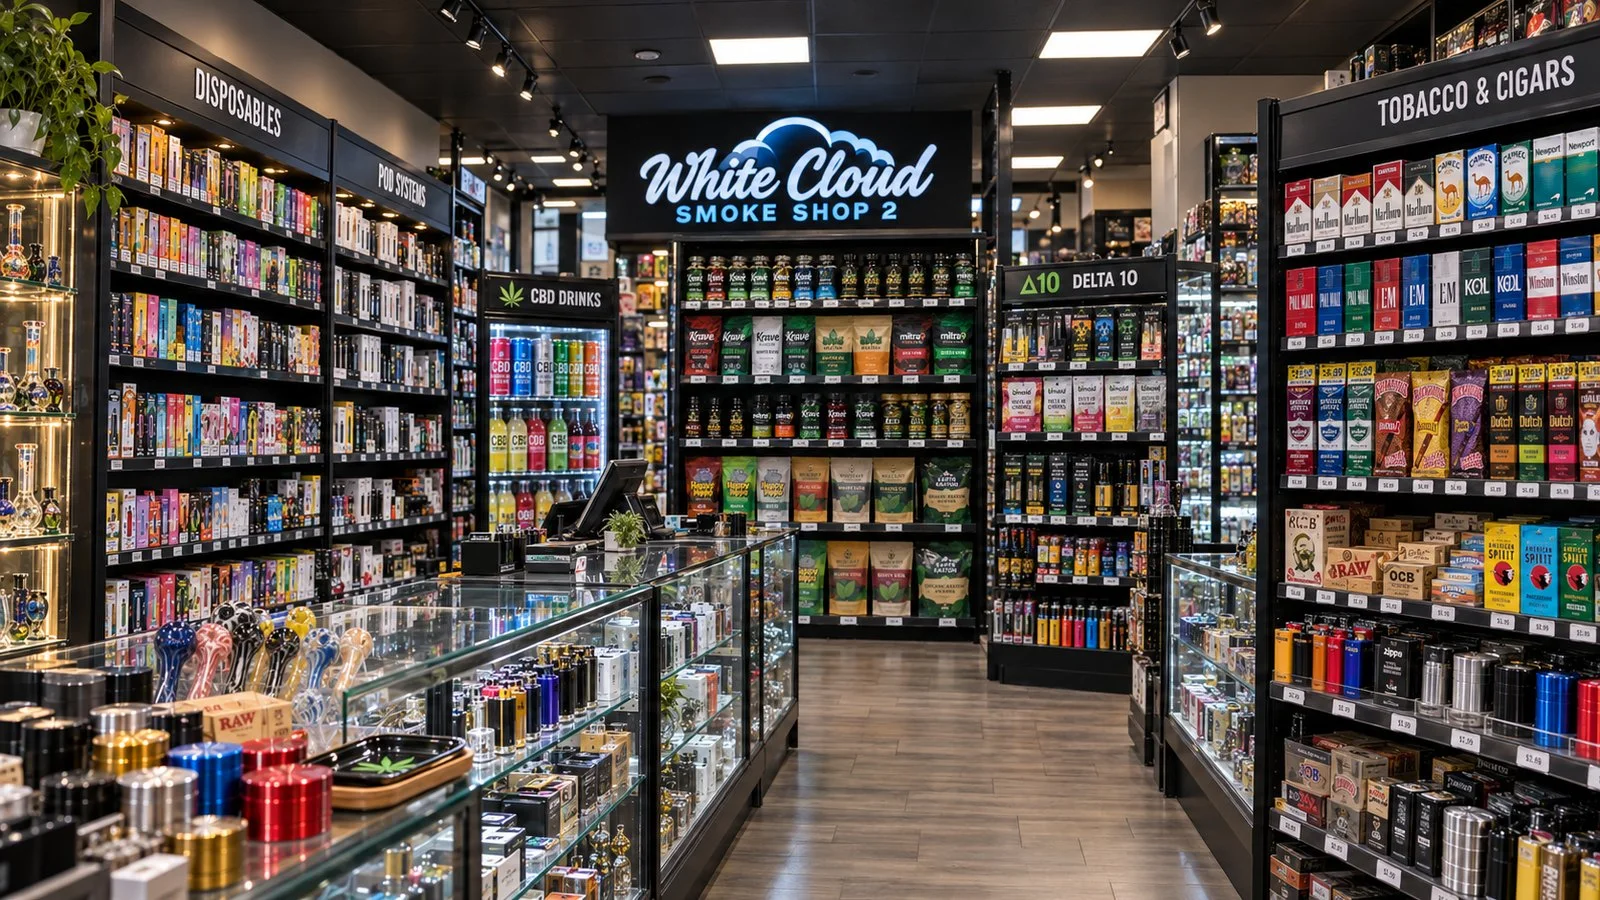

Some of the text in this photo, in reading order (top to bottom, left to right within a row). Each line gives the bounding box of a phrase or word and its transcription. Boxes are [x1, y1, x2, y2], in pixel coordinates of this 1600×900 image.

[1377, 55, 1575, 127] TOBACCO & CIGARS
[195, 67, 282, 138] DISPOSABLES
[1535, 145, 1561, 157] Newport
[1568, 138, 1595, 151] Newport
[639, 143, 938, 205] White Cloud
[378, 162, 427, 208] POD SYSTEMS
[676, 201, 898, 224] SMOKE SHOP 2
[1375, 202, 1401, 220] Marlboro
[1406, 198, 1433, 217] Marlboro
[1286, 217, 1309, 234] Marlboro
[1315, 212, 1338, 230] Marlboro
[1344, 208, 1369, 226] Marlboro
[1072, 271, 1115, 289] DELTA
[1119, 269, 1138, 286] 10
[1529, 275, 1554, 289] Winston
[1562, 272, 1589, 286] Winston
[531, 287, 601, 307] CBD DRINKS
[689, 331, 715, 341] Krave
[722, 331, 746, 342] Krave
[756, 332, 780, 342] Krave
[785, 331, 810, 341] Krave
[1491, 415, 1513, 428] Dutch
[1520, 415, 1543, 427] Dutch
[1550, 415, 1573, 427] Dutch
[1337, 560, 1370, 578] RAW
[1390, 570, 1415, 583] OCB
[218, 711, 256, 731] RAW
